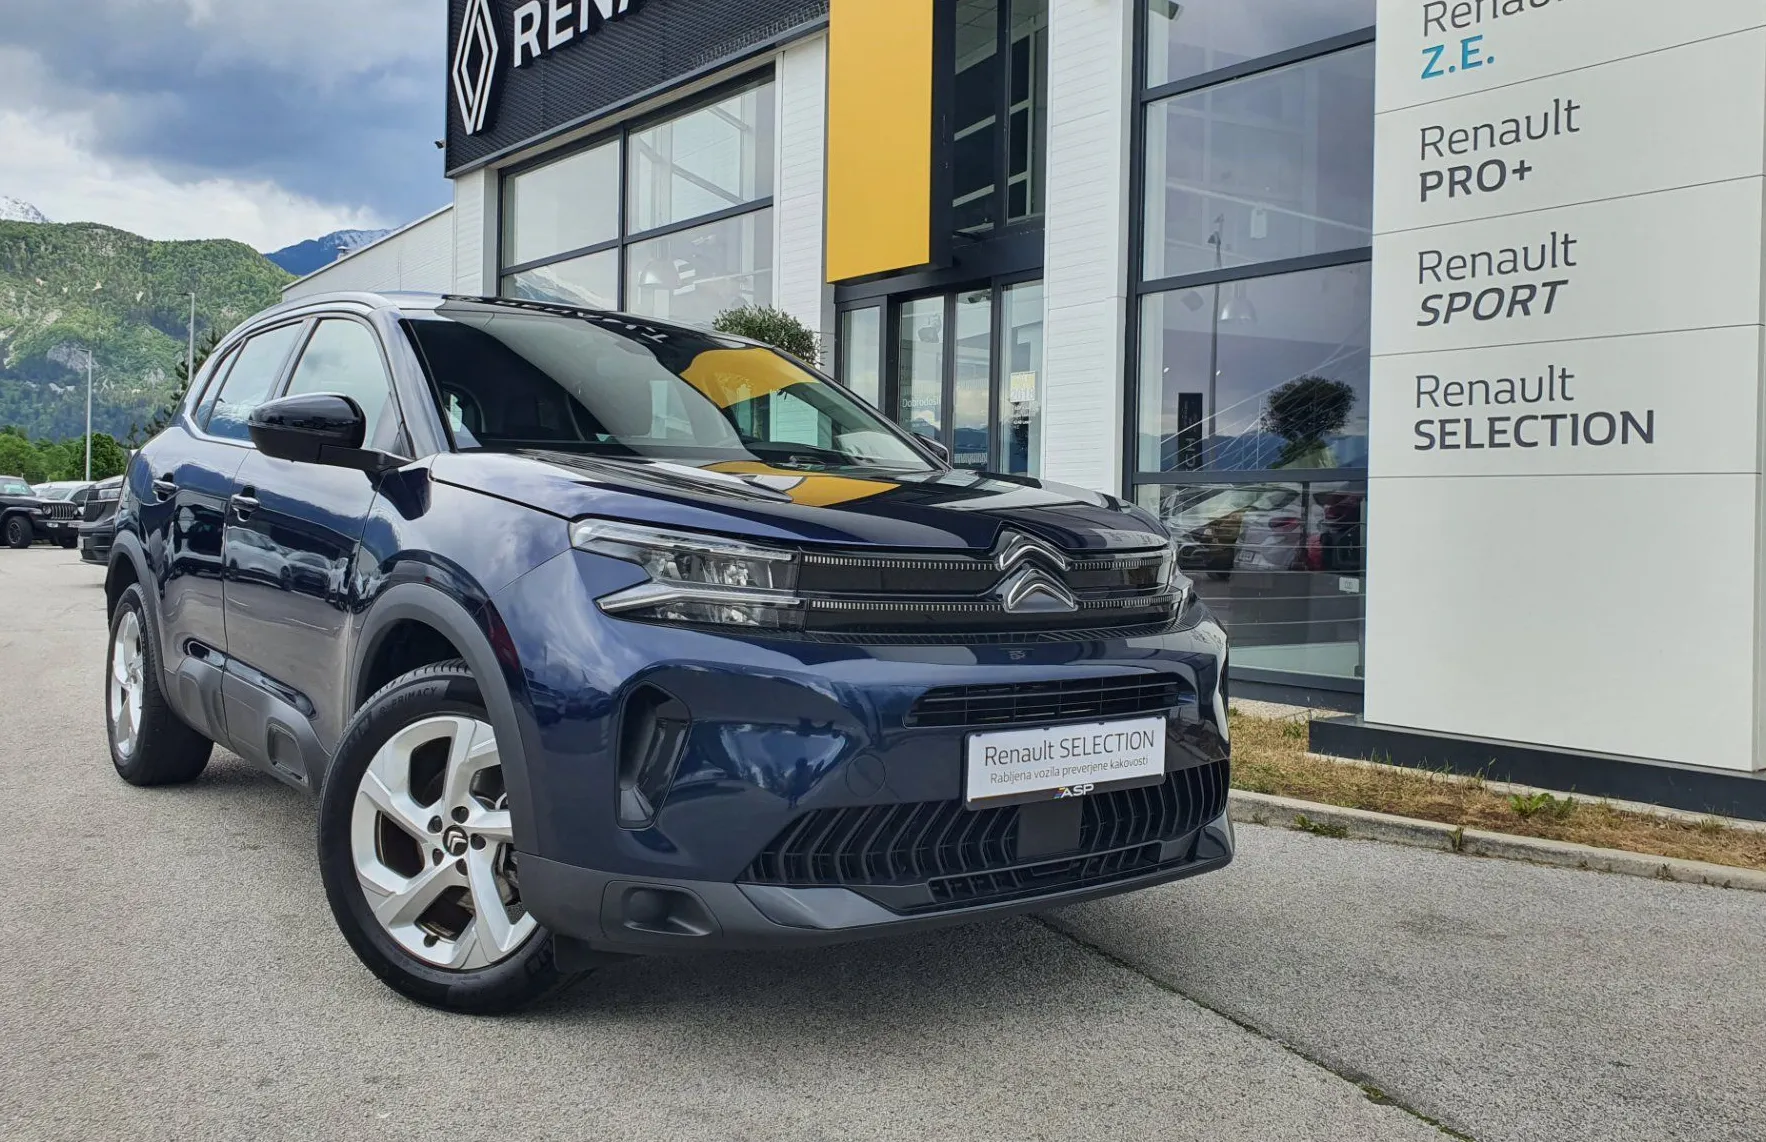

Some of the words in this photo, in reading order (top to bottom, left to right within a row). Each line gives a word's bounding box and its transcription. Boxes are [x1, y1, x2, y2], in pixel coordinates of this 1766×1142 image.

[1421, 34, 1495, 79] Z.E.
[1420, 98, 1581, 160] Renault
[1419, 158, 1533, 203] PRO+
[1418, 231, 1578, 285] Renault
[1416, 279, 1569, 327] SPORT
[1415, 364, 1575, 408] Renault
[1414, 409, 1654, 451] SELECTION
[985, 739, 1055, 767] Renault
[1060, 730, 1155, 758] SELECTION
[990, 771, 1032, 784] Rabljena
[1034, 766, 1060, 778] vozila
[1062, 761, 1108, 778] preverjene
[1110, 756, 1149, 770] kakovosti
